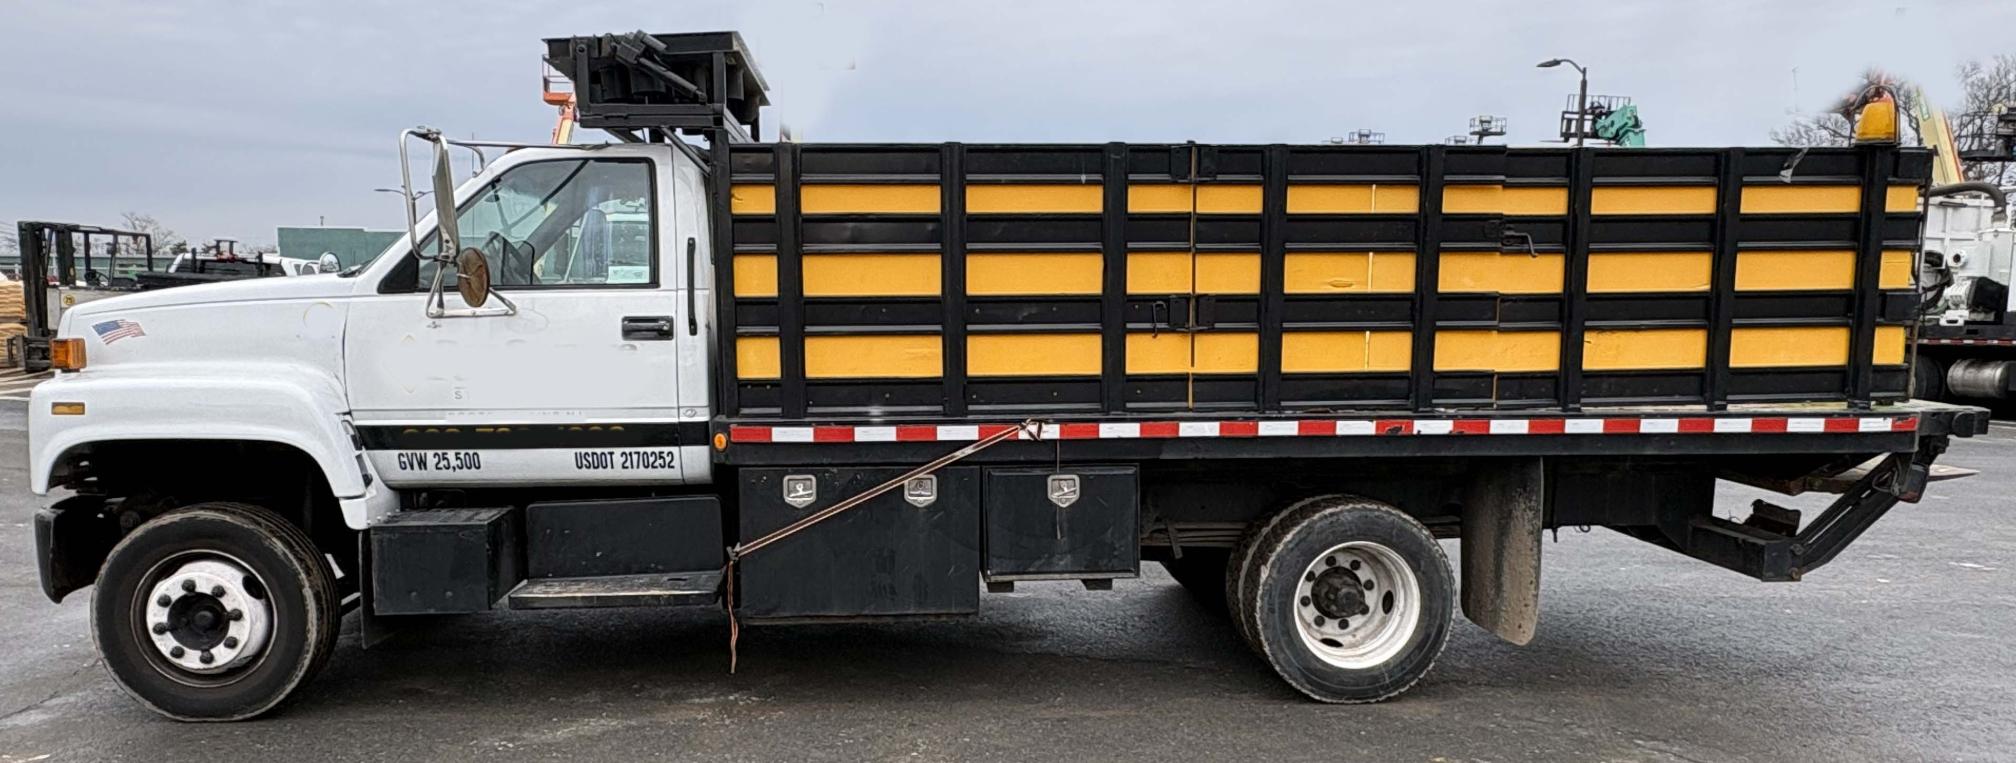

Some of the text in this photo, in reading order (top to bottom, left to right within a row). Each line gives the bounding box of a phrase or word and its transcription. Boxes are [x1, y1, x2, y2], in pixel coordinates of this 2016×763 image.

[398, 452, 481, 472] GVW 25,500
[575, 451, 675, 469] USDOT 2170252
